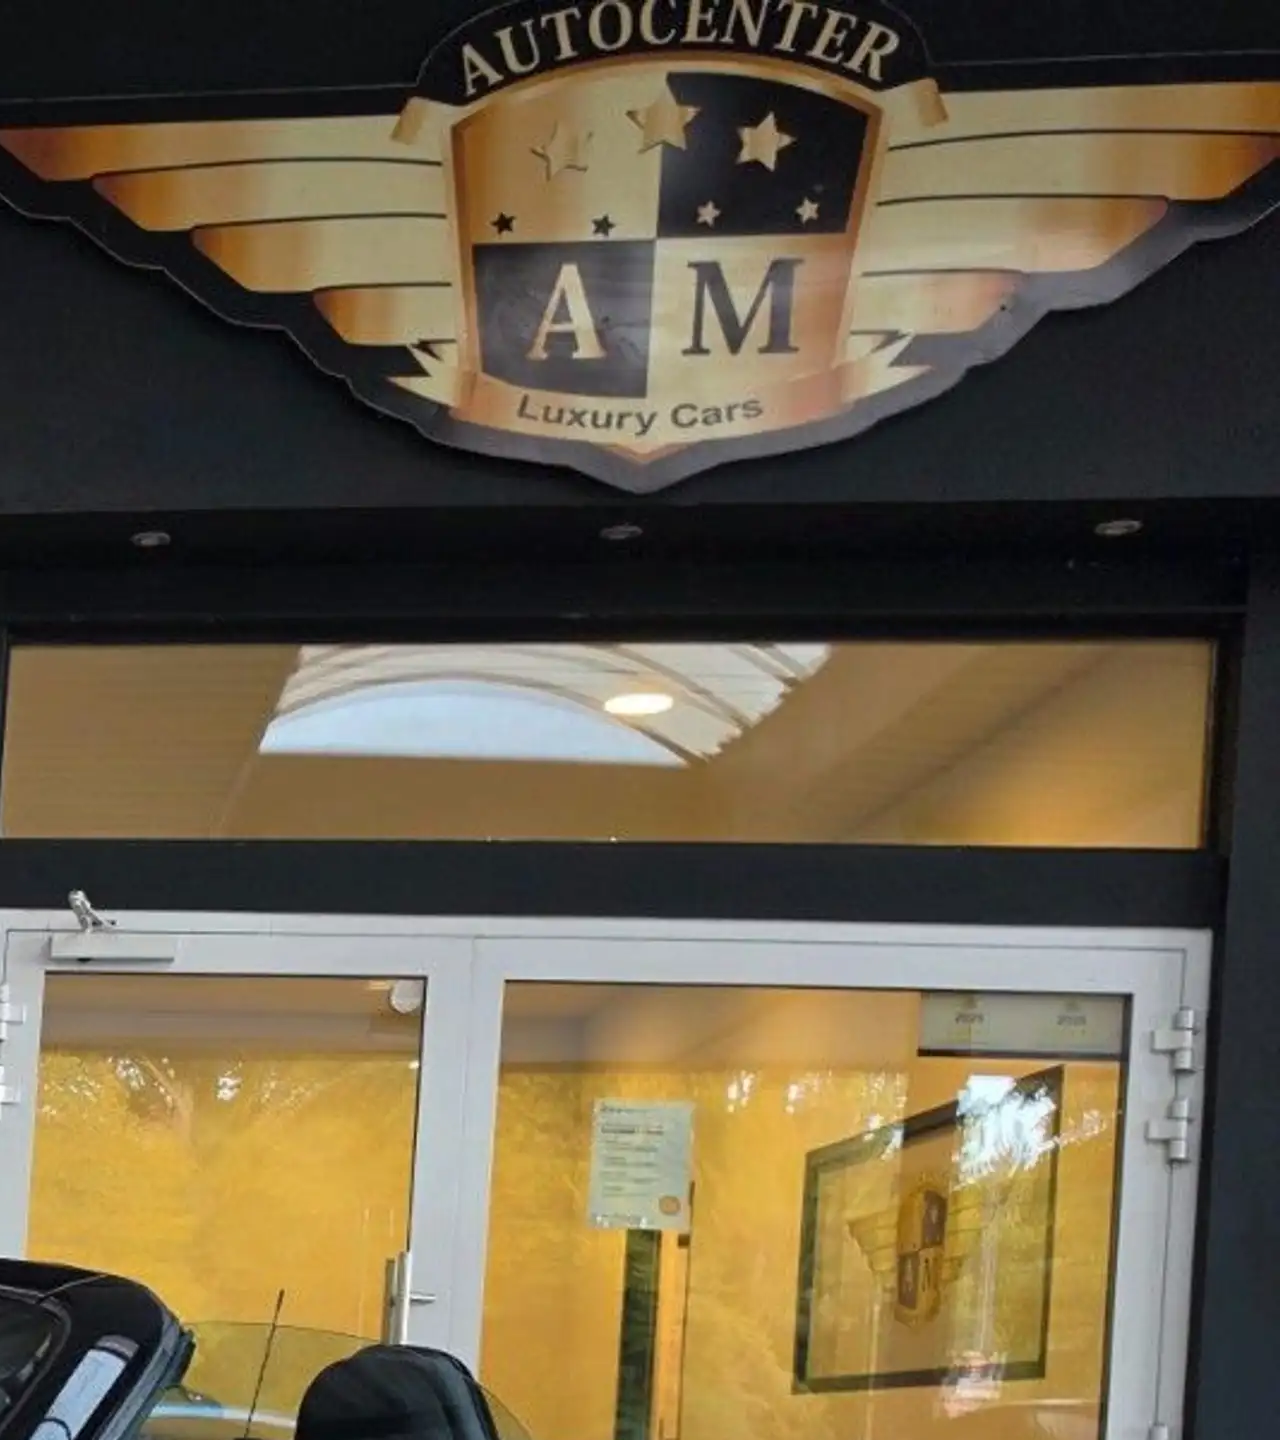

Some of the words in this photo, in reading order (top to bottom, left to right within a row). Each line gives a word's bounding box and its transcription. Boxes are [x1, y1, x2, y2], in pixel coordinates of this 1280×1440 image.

[460, 0, 901, 96] AUTOCENTER
[516, 394, 659, 436] Luxury
[670, 396, 765, 430] Cars
